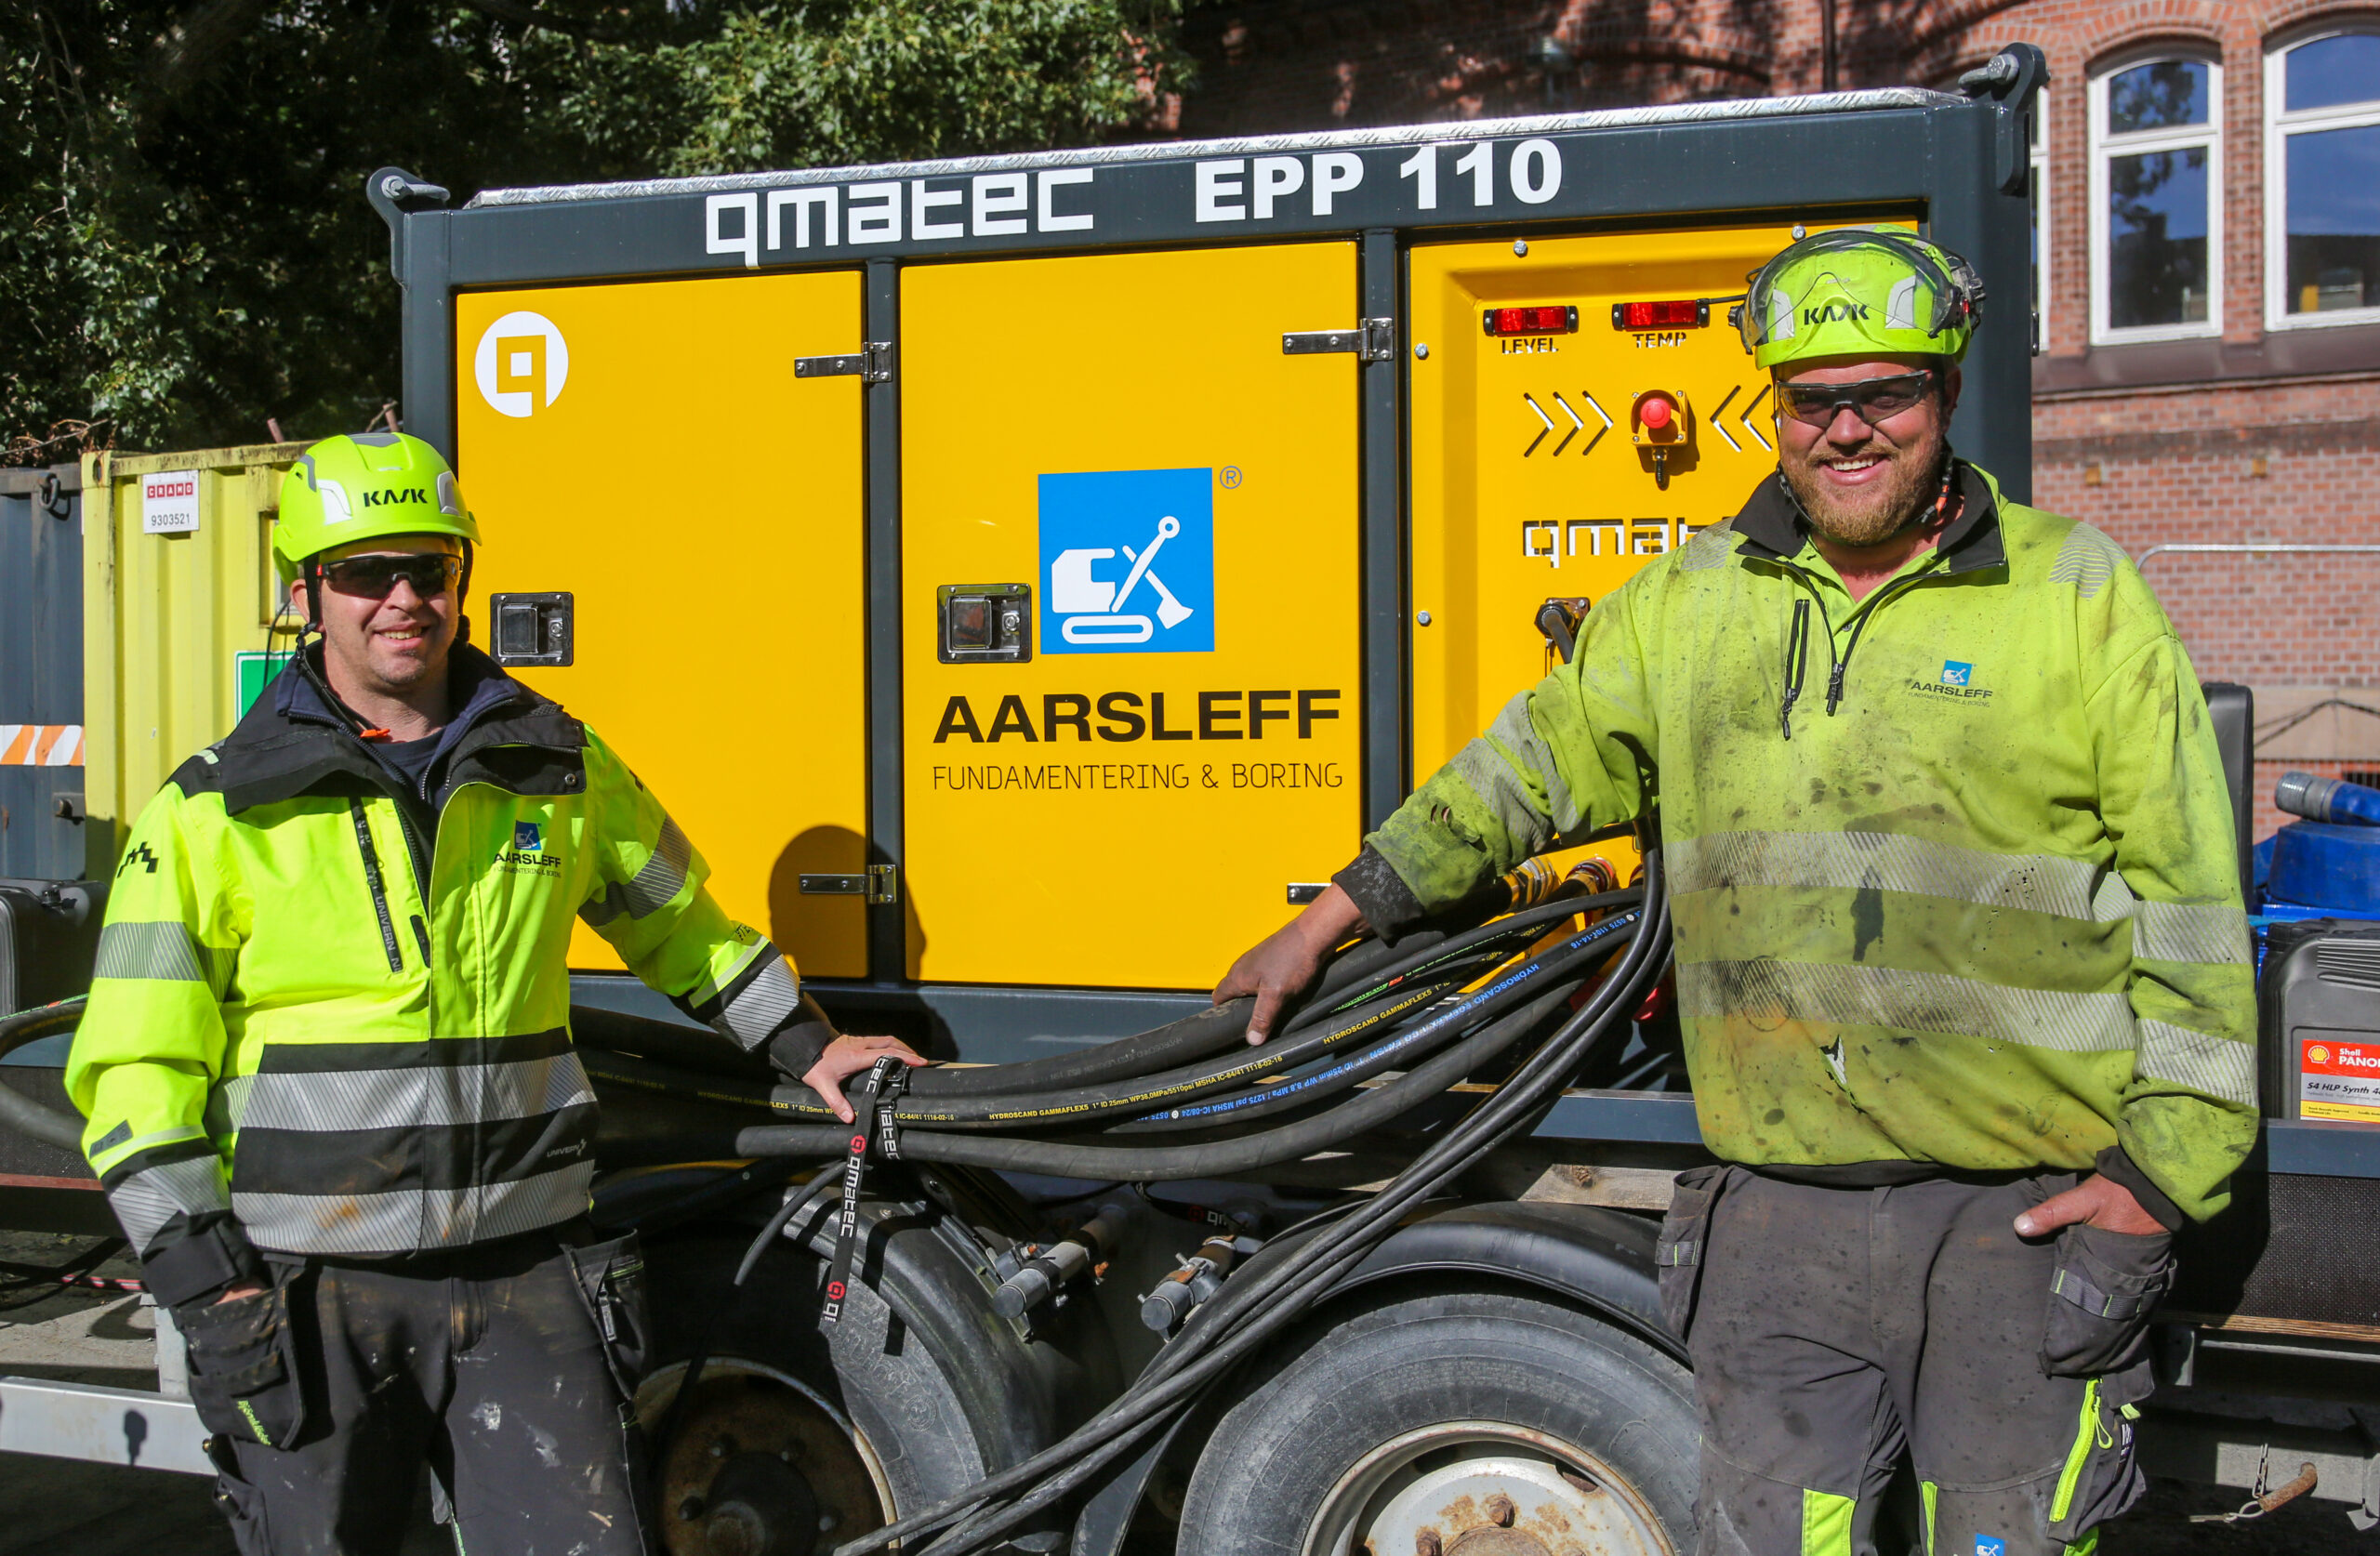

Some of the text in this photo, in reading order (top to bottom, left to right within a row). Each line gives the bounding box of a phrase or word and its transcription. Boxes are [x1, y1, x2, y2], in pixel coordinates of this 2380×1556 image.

[705, 138, 1563, 270] qmatec EPP 110
[1804, 304, 1870, 325] KASK
[1501, 337, 1559, 354] LEVEL
[1633, 332, 1686, 349] TEMP
[148, 482, 192, 498] CRAMO
[363, 488, 429, 508] KASK
[151, 513, 191, 526] 9303521
[1911, 681, 1992, 699] AARSLEFF
[932, 689, 1341, 743] AARSLEFF
[932, 762, 1342, 790] FUNDAMENTERING & BORING
[494, 851, 562, 868] AARSLEFF
[375, 896, 396, 951] UNIVERN
[1473, 964, 1540, 1004] HYDROSCAND
[1323, 1015, 1379, 1045] HYDROSCAND
[1380, 989, 1433, 1019] GAMMAFLEX5
[2339, 1048, 2360, 1056] Shell
[989, 1110, 1038, 1120] HYDROSCAND
[1038, 1103, 1090, 1116] GAMMAFLEX5
[1195, 1075, 1217, 1088] MSHA
[1249, 1094, 1266, 1104] 1275
[2342, 1085, 2370, 1094] Synth
[1212, 1101, 1235, 1112] MSHA
[840, 1157, 861, 1238] qmatec
